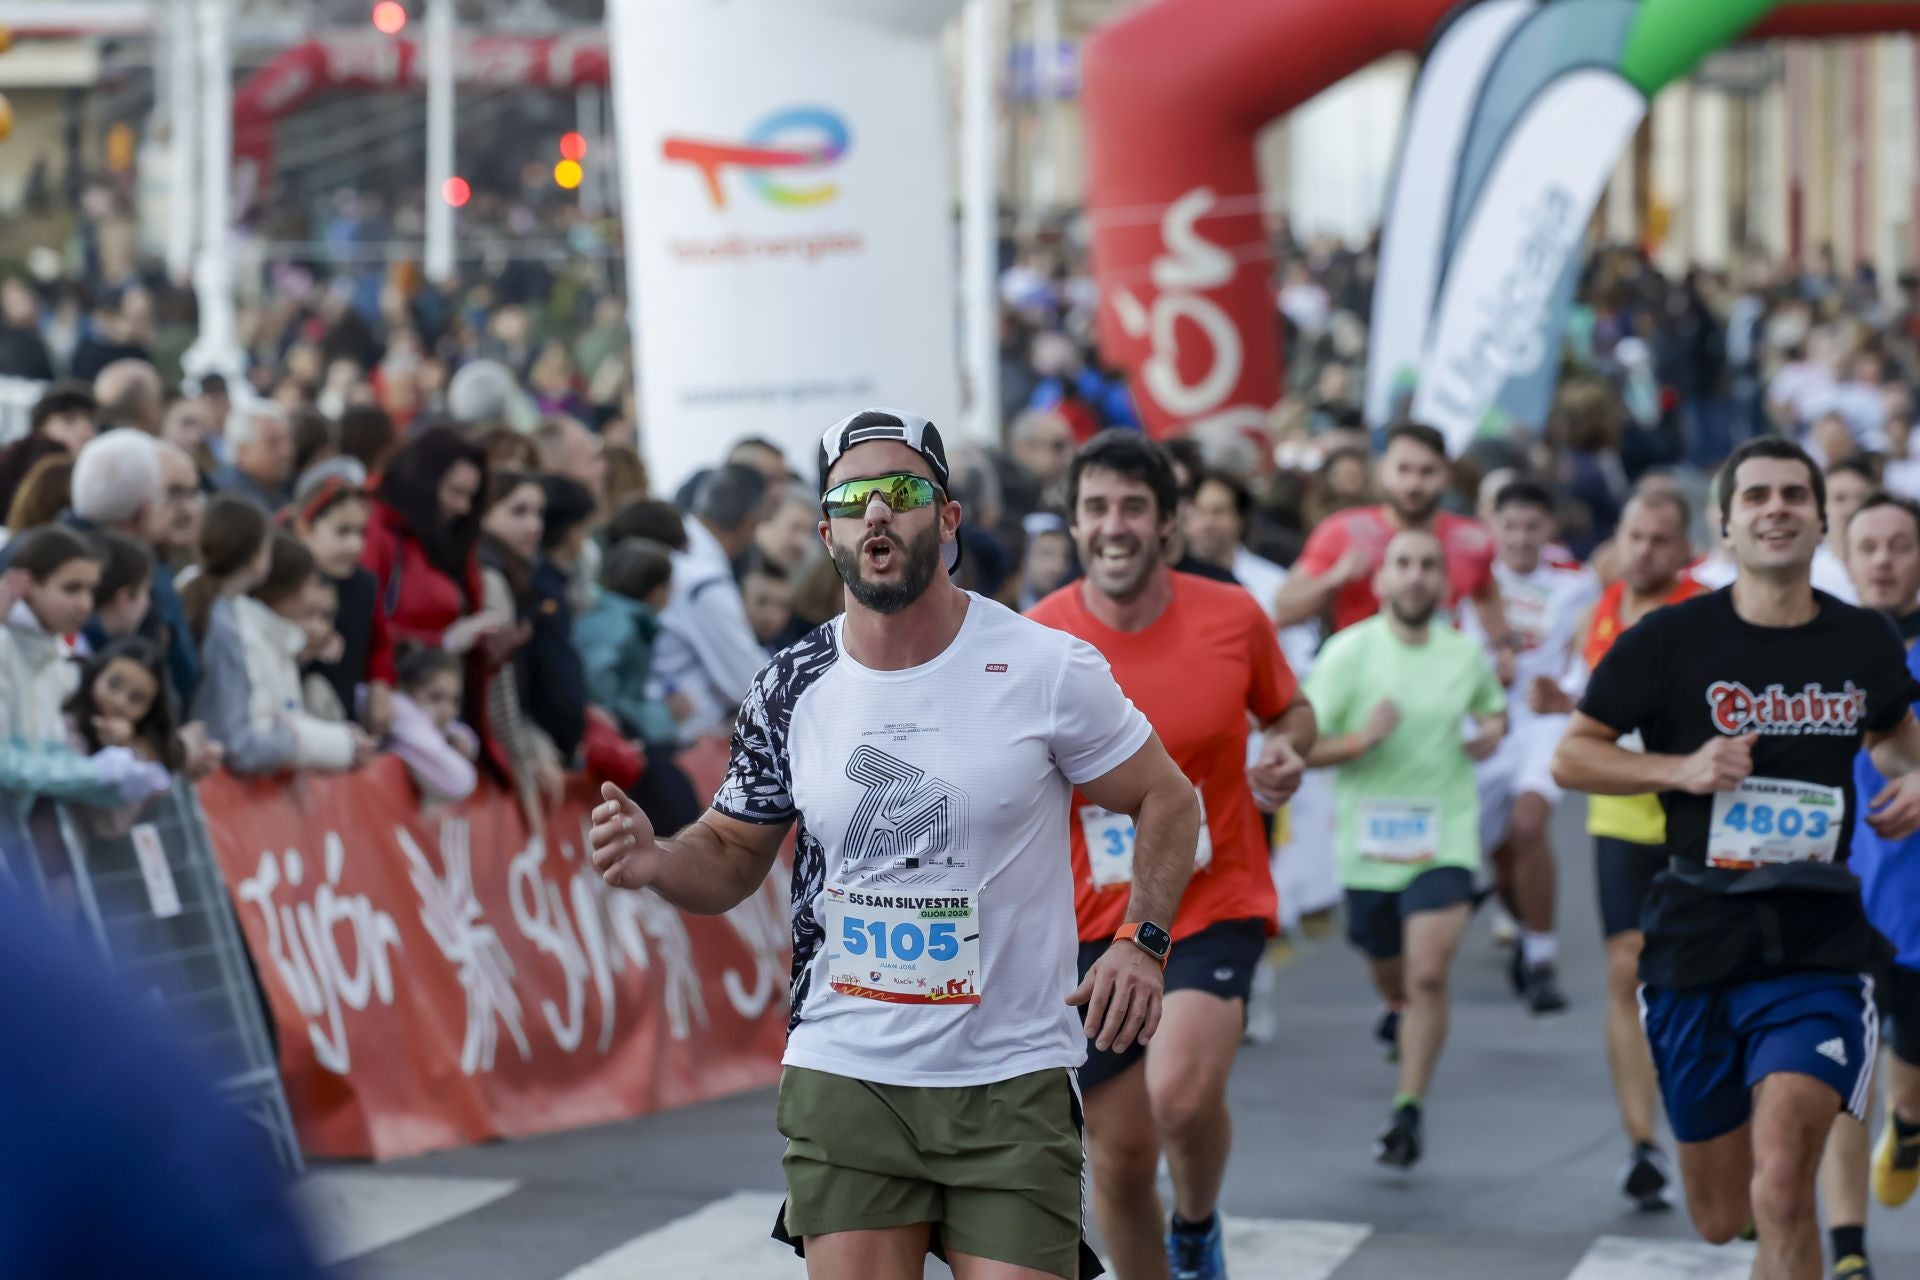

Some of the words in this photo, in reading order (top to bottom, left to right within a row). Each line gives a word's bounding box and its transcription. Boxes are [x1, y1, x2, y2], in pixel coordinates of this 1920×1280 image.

[1724, 802, 1829, 839] 4803
[849, 893, 864, 905] 55
[865, 895, 893, 908] SAN
[896, 896, 969, 909] SILVESTRE
[921, 910, 946, 918] GIJÓN
[843, 916, 959, 961] 5105
[899, 962, 916, 970] JOSÉ
